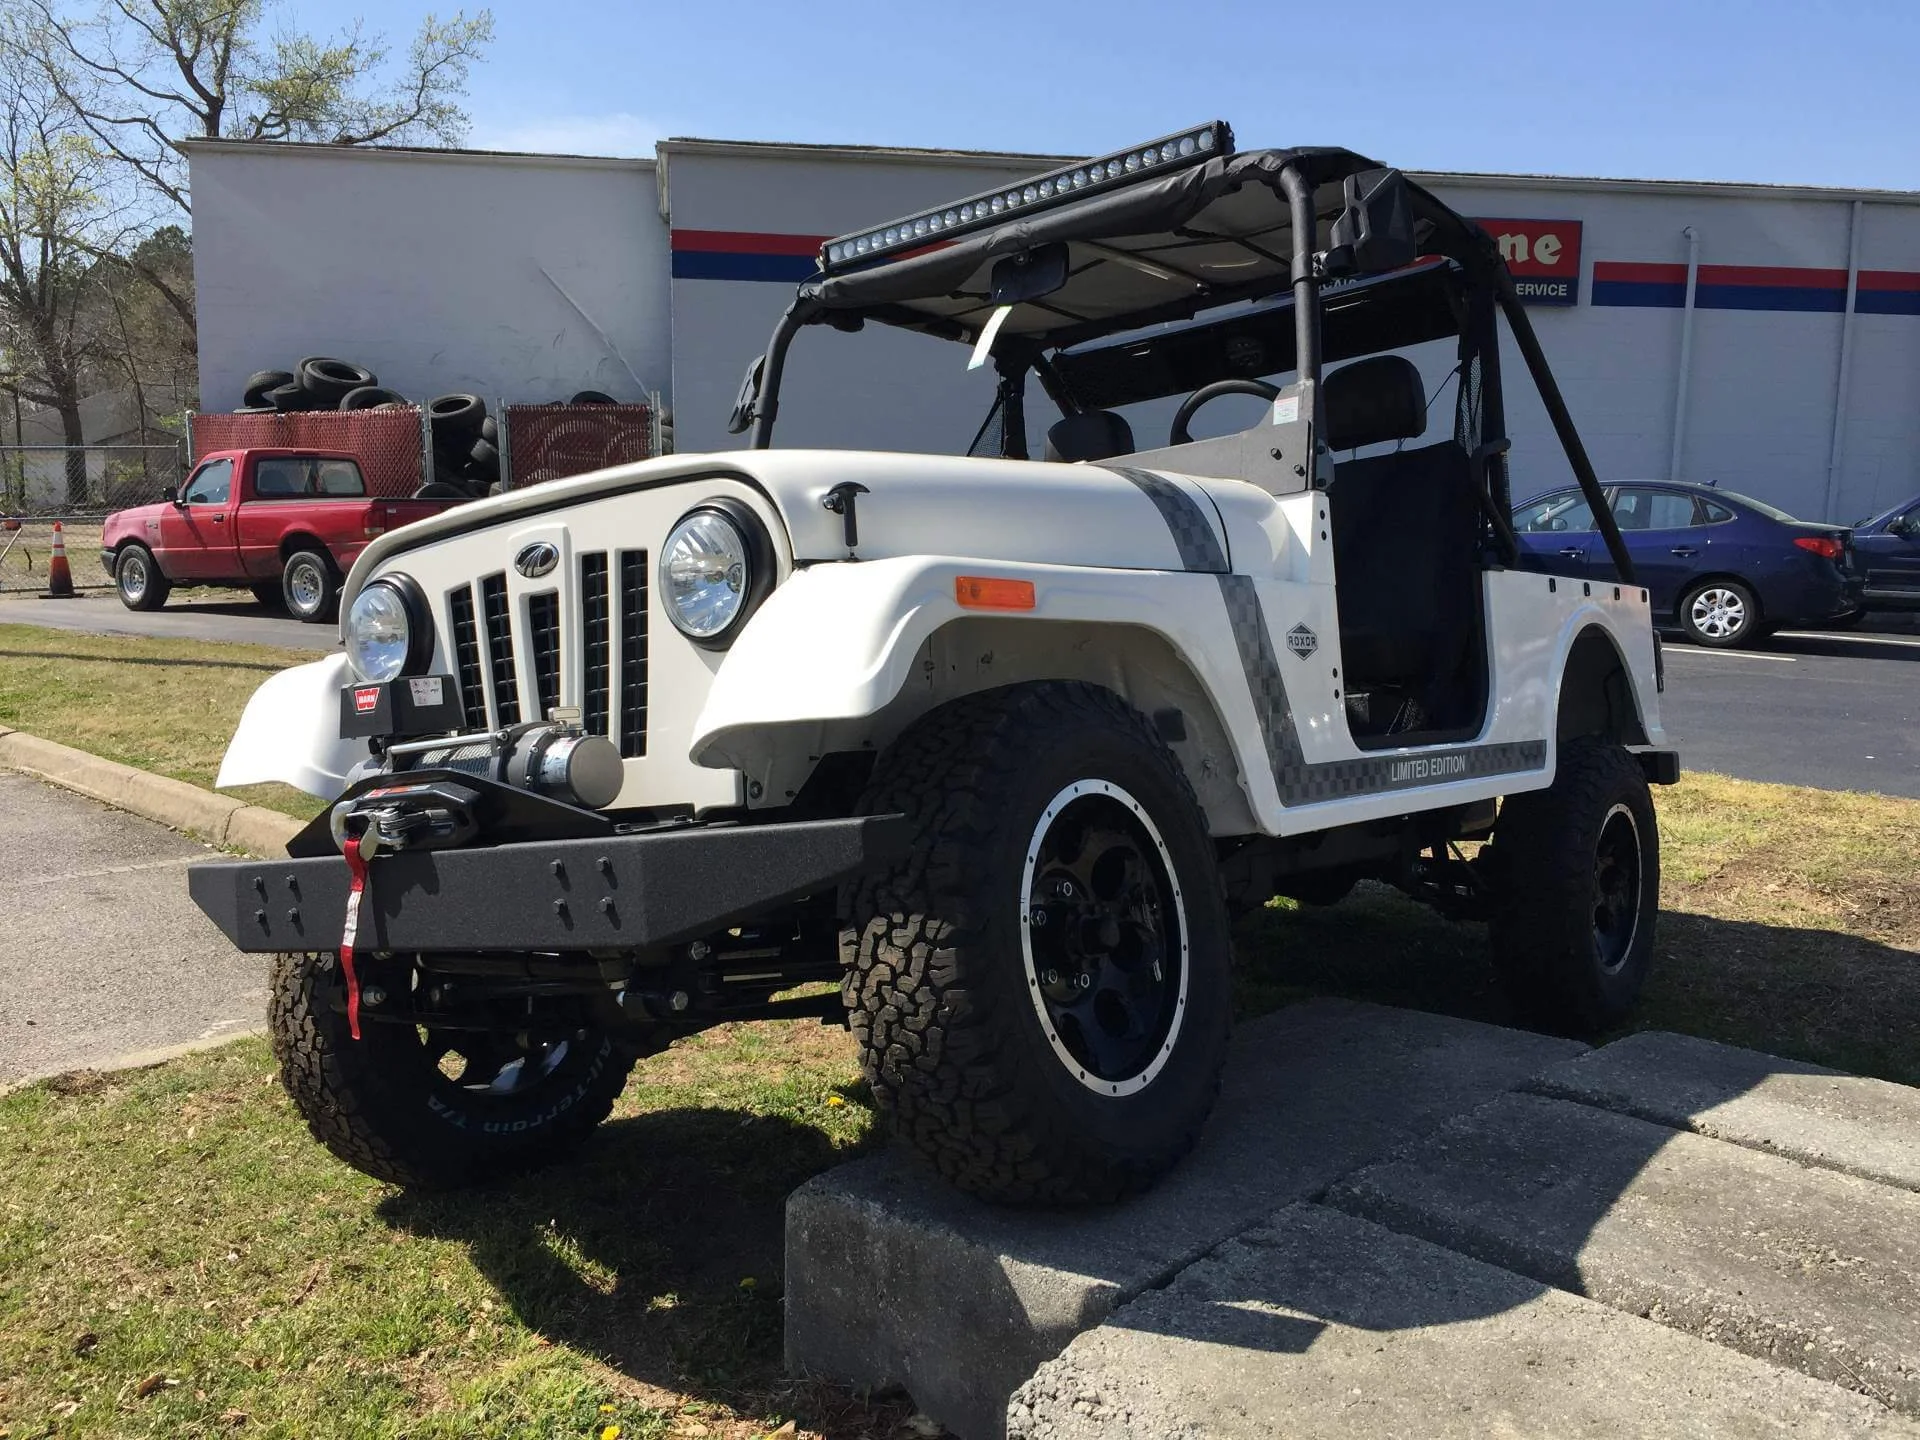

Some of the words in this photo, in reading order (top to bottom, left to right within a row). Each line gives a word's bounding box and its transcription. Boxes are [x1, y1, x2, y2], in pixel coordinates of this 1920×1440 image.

[1515, 283, 1567, 296] ERVICE
[1288, 635, 1317, 648] ROXOR
[1391, 760, 1429, 782] LIMITED
[1430, 755, 1465, 776] EDITION
